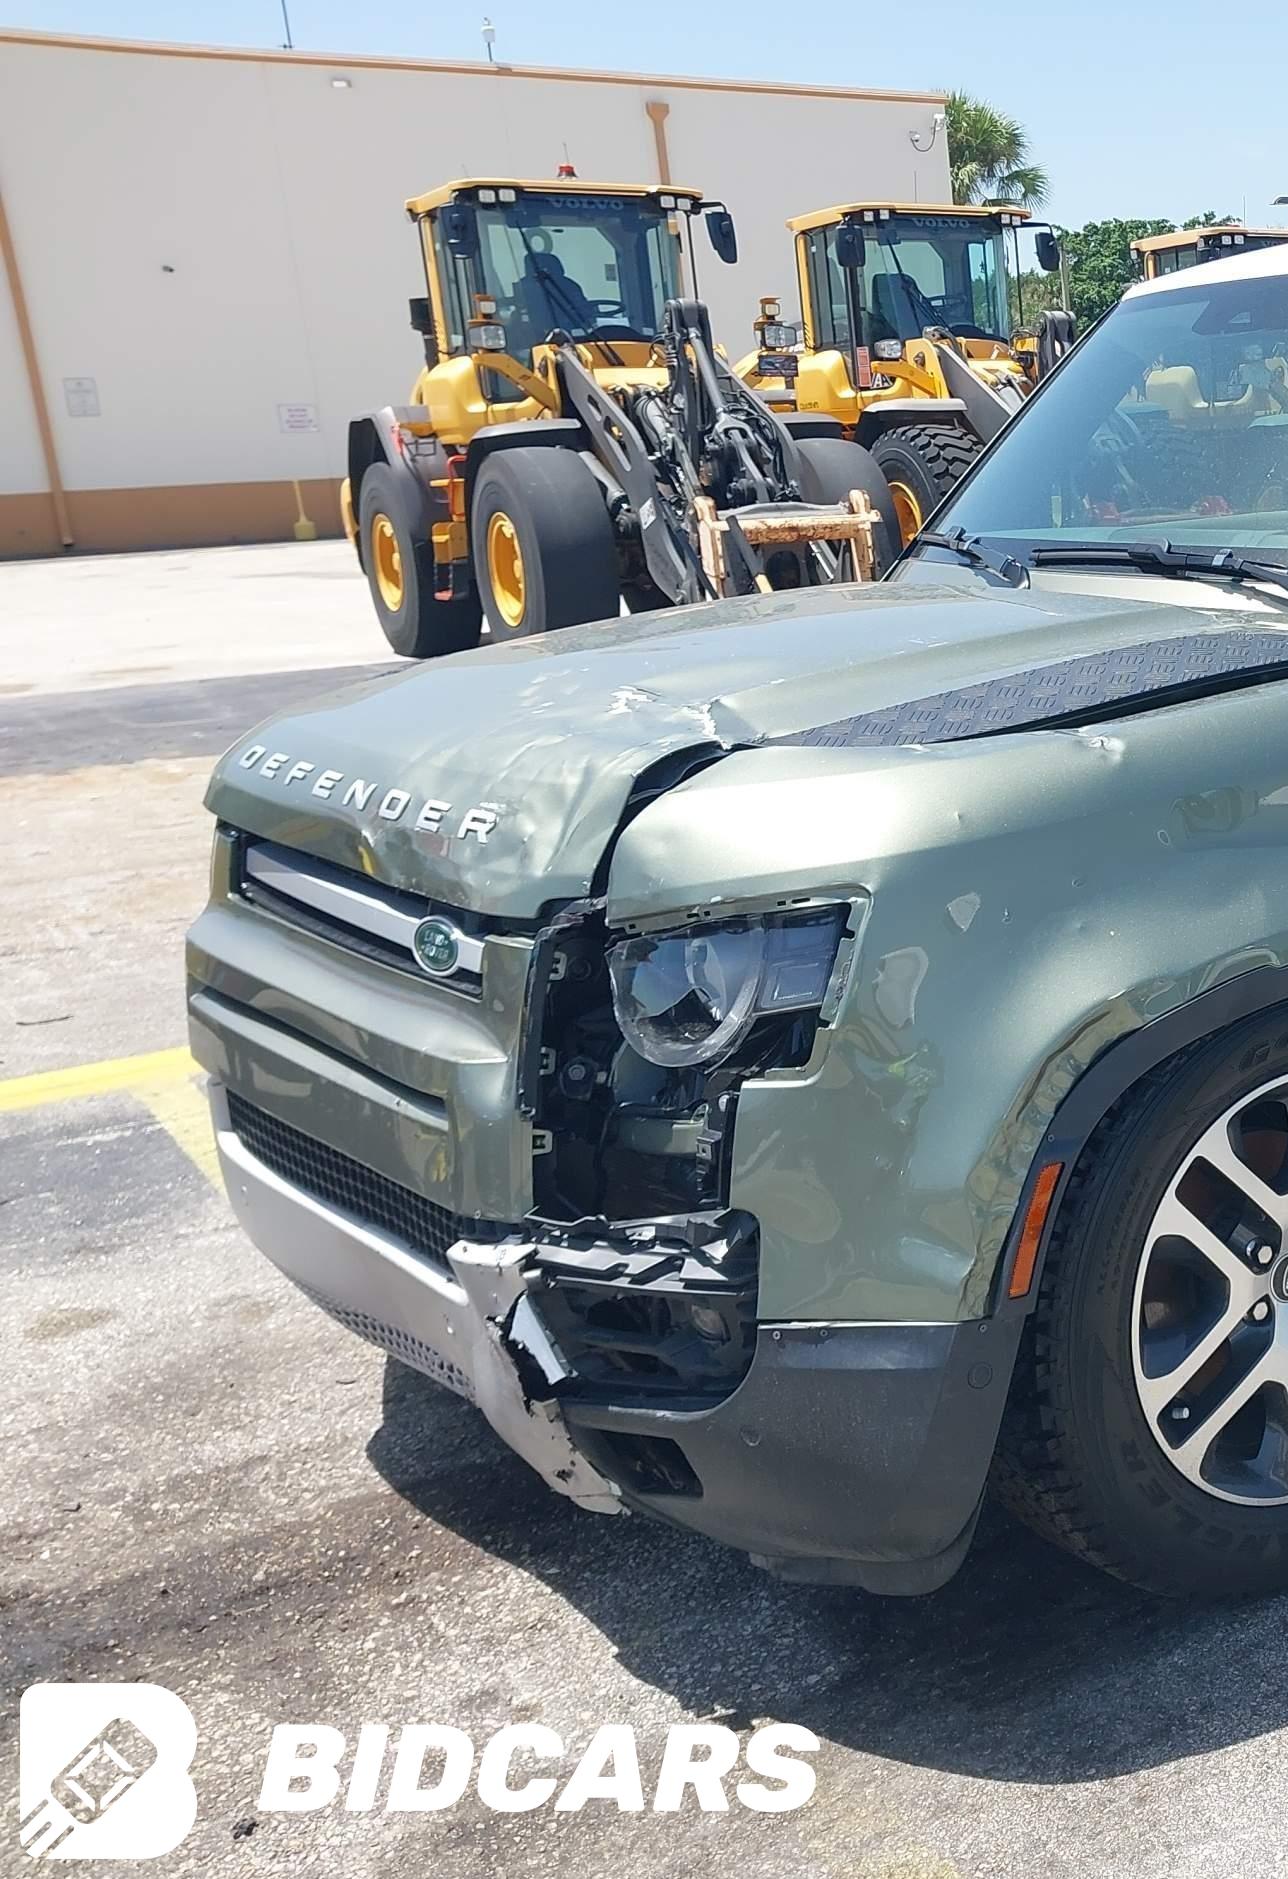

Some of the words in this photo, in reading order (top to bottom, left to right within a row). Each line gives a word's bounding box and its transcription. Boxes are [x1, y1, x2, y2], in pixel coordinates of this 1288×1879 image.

[545, 196, 624, 210] VOLVO
[912, 217, 970, 228] VOLVO
[239, 744, 500, 844] DEFENDER
